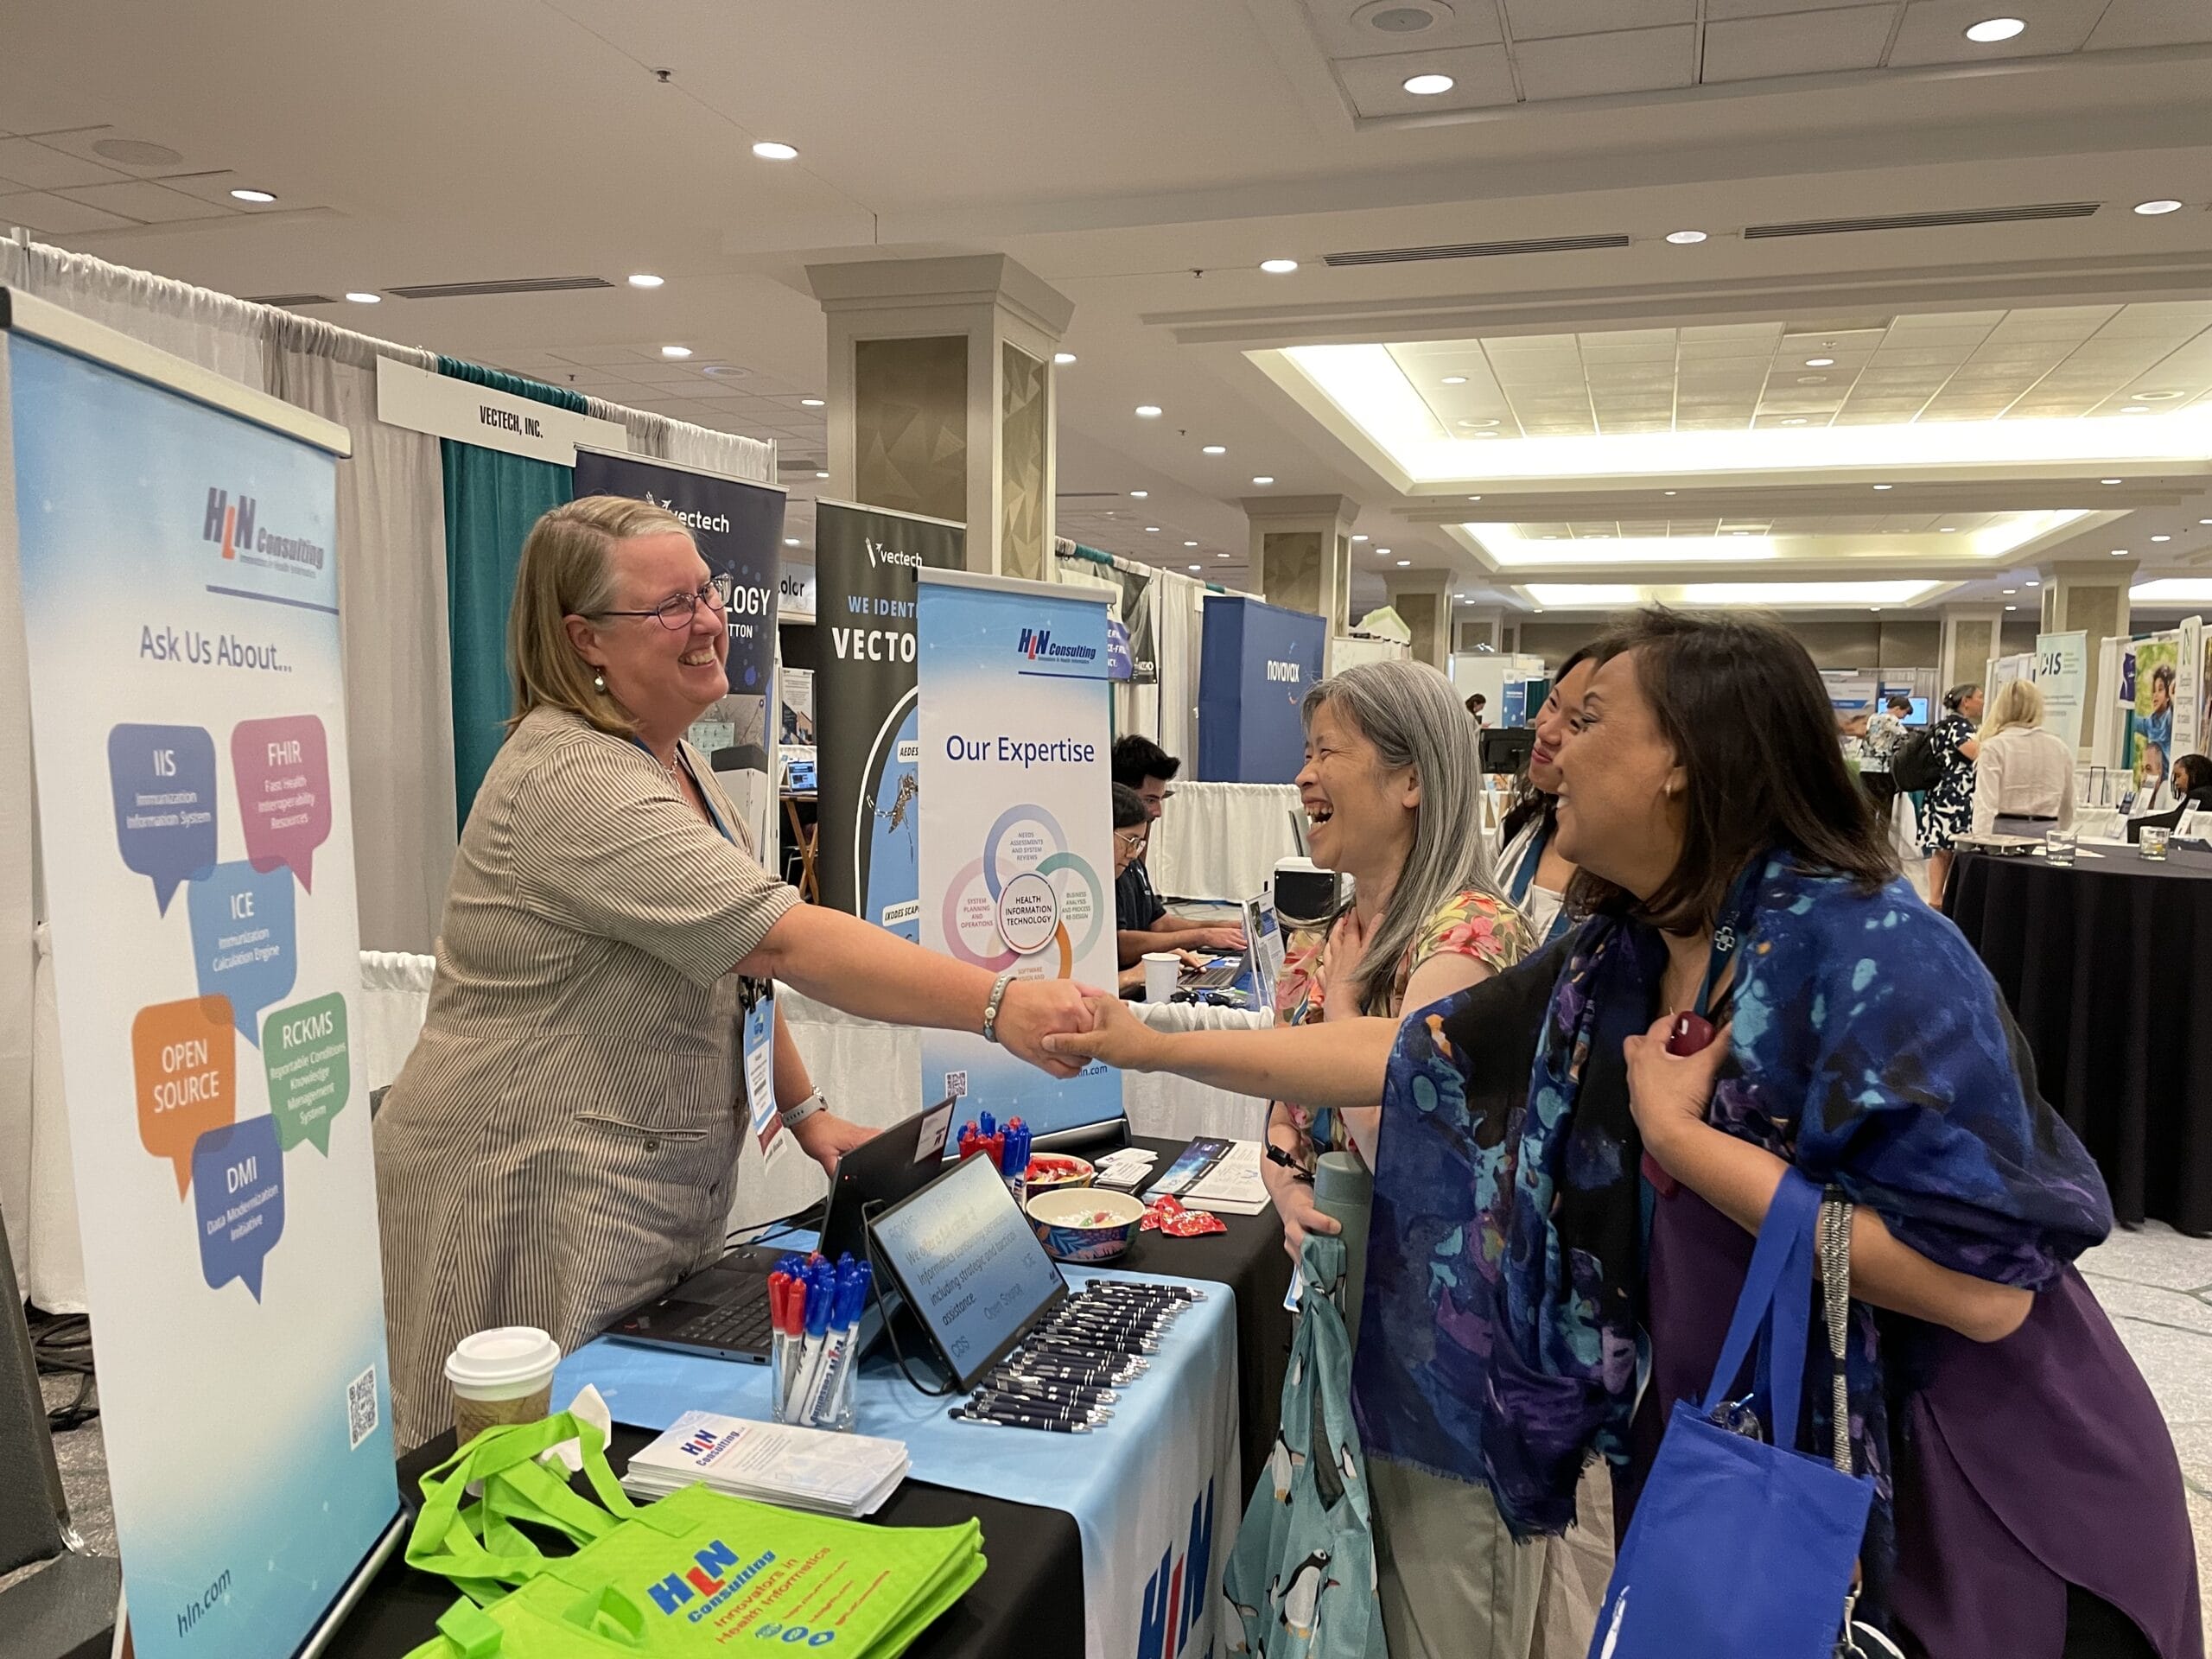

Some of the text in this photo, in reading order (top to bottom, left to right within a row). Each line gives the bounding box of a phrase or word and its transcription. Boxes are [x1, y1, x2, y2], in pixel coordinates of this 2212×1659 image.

[480, 405, 543, 439] VECTECH, INC.
[203, 487, 257, 560] HLN
[257, 527, 324, 570] Consulting
[880, 550, 923, 568] vectech
[779, 575, 805, 597] olor
[848, 595, 869, 614] WE
[140, 626, 292, 672] Ask Us About...
[1018, 628, 1096, 660] HLN Consulting
[1268, 660, 1300, 683] novavax
[153, 750, 176, 777] IIS
[268, 741, 302, 766] FHIR
[899, 747, 918, 756] AEDES
[946, 735, 1095, 768] Our Expertise
[264, 779, 283, 792] Fast
[180, 810, 212, 828] System
[231, 892, 254, 919] ICE
[885, 906, 919, 921] IXODES SCAP
[1005, 905, 1052, 915] INFORMATION
[1007, 916, 1052, 926] TECHNOLOGY
[283, 1011, 333, 1049] RCKMS
[162, 1039, 208, 1073] OPEN
[153, 1071, 219, 1113] SOURCE
[226, 1156, 257, 1193] DMI
[207, 1216, 226, 1235] Data
[918, 1255, 956, 1286] Informatics
[929, 1277, 962, 1306] including
[959, 1255, 987, 1282] strategic
[985, 1247, 997, 1261] and
[681, 1429, 717, 1457] HLN
[696, 1431, 741, 1466] Consulting
[646, 1540, 740, 1616] HLN
[688, 1549, 776, 1623] Consulting
[714, 1571, 785, 1628] Innovators
[784, 1558, 798, 1569] in
[176, 1569, 232, 1638] hln.com
[715, 1608, 764, 1644] Health
[761, 1547, 831, 1605] Informatics
